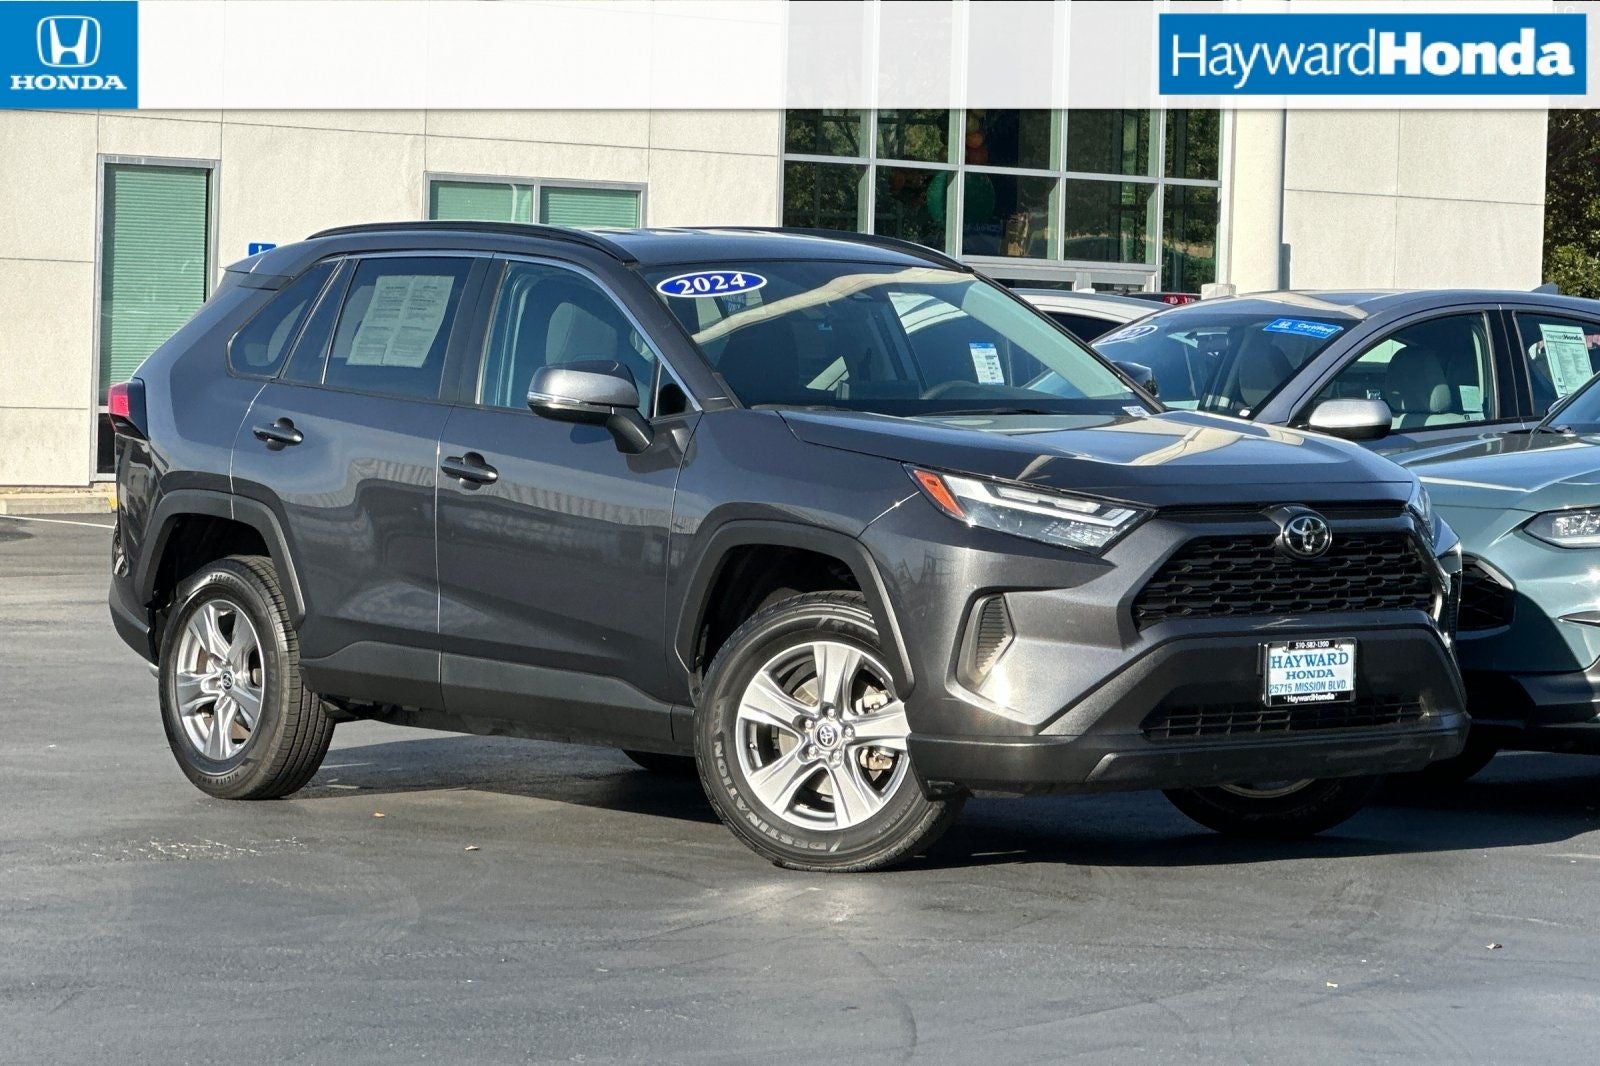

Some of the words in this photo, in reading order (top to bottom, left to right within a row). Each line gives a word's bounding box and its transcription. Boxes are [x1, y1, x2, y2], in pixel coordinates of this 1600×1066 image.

[675, 272, 747, 295] 2024
[1270, 652, 1349, 669] HAYWARD
[1286, 669, 1335, 680] HONDA
[1269, 683, 1293, 694] 25715
[1294, 681, 1326, 692] MISSION
